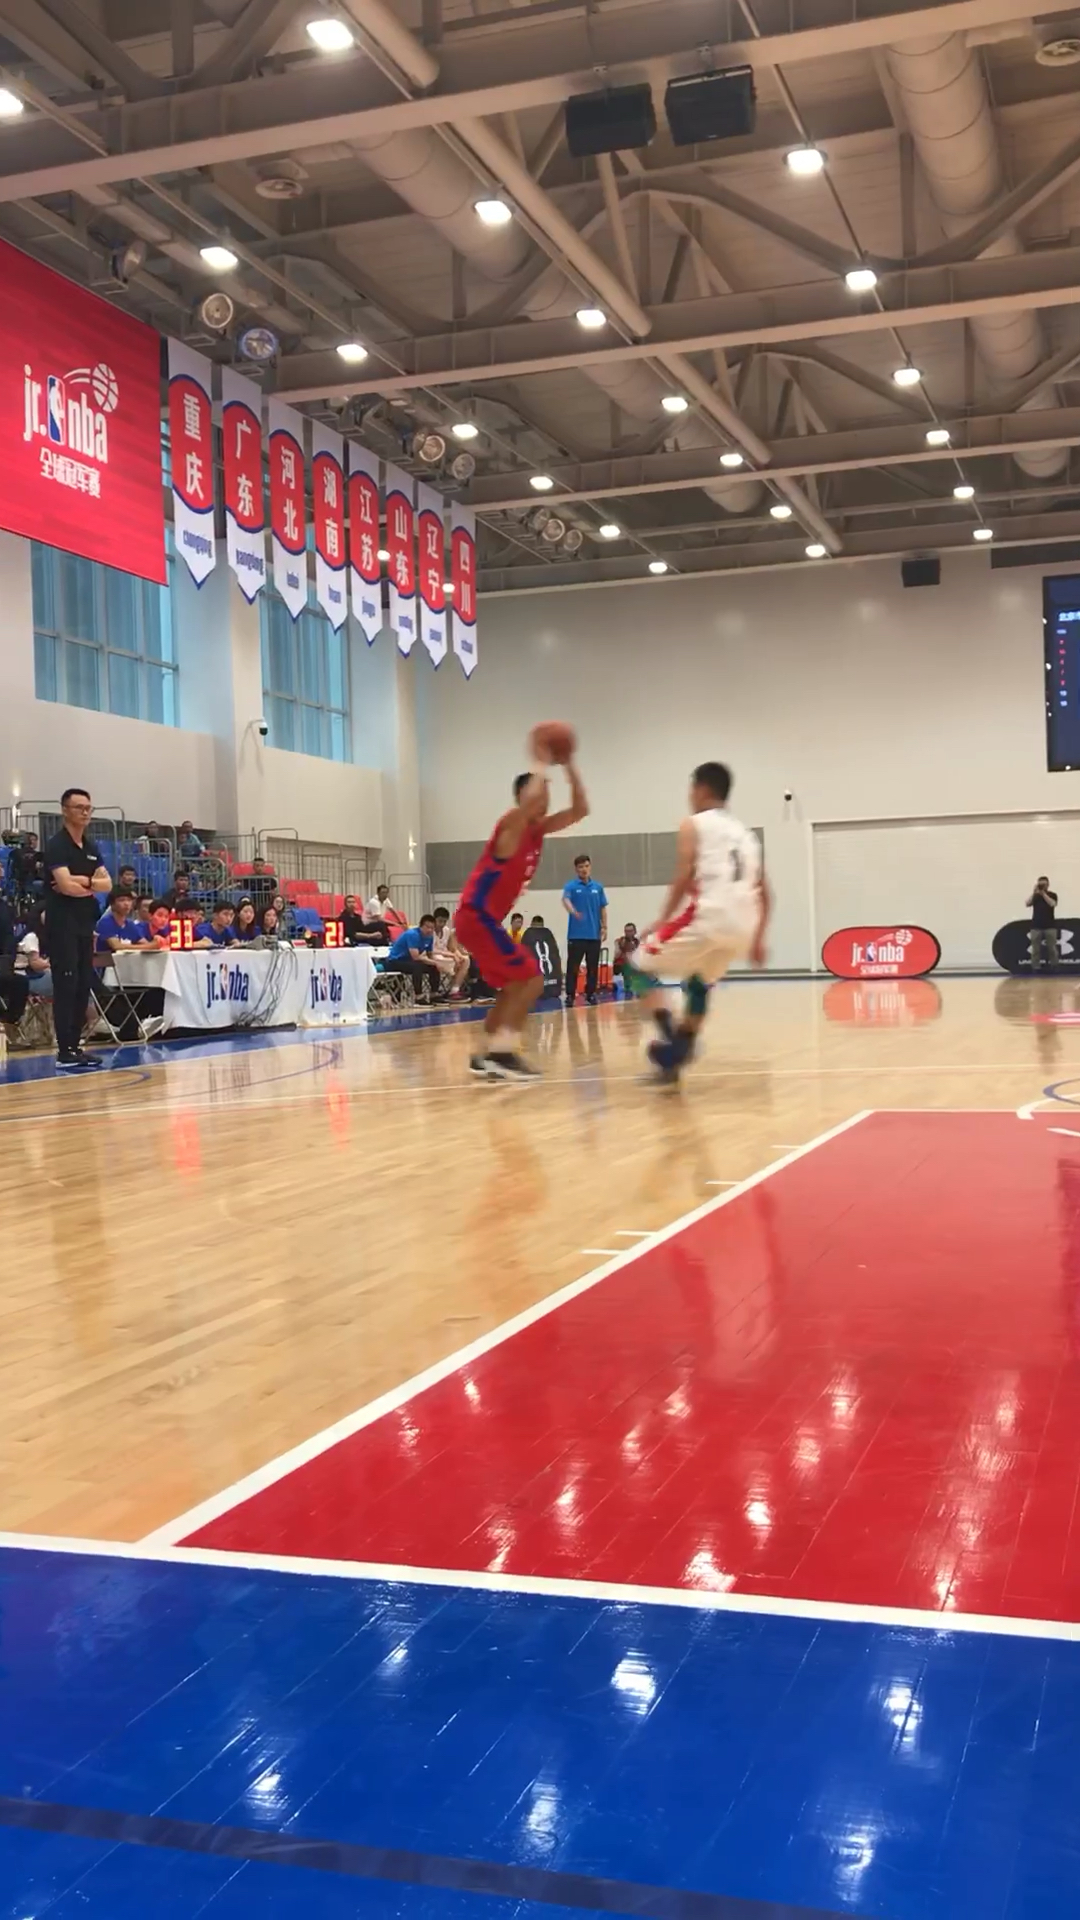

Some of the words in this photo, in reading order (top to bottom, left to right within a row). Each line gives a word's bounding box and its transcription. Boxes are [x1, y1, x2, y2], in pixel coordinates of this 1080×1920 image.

[68, 392, 108, 464] nba
[184, 393, 204, 500] 重庆
[236, 419, 255, 517] 广东
[281, 445, 299, 541] 河北
[395, 505, 410, 587] 山东
[460, 540, 472, 615] 四川
[325, 921, 345, 947] 21
[878, 942, 904, 962] nba
